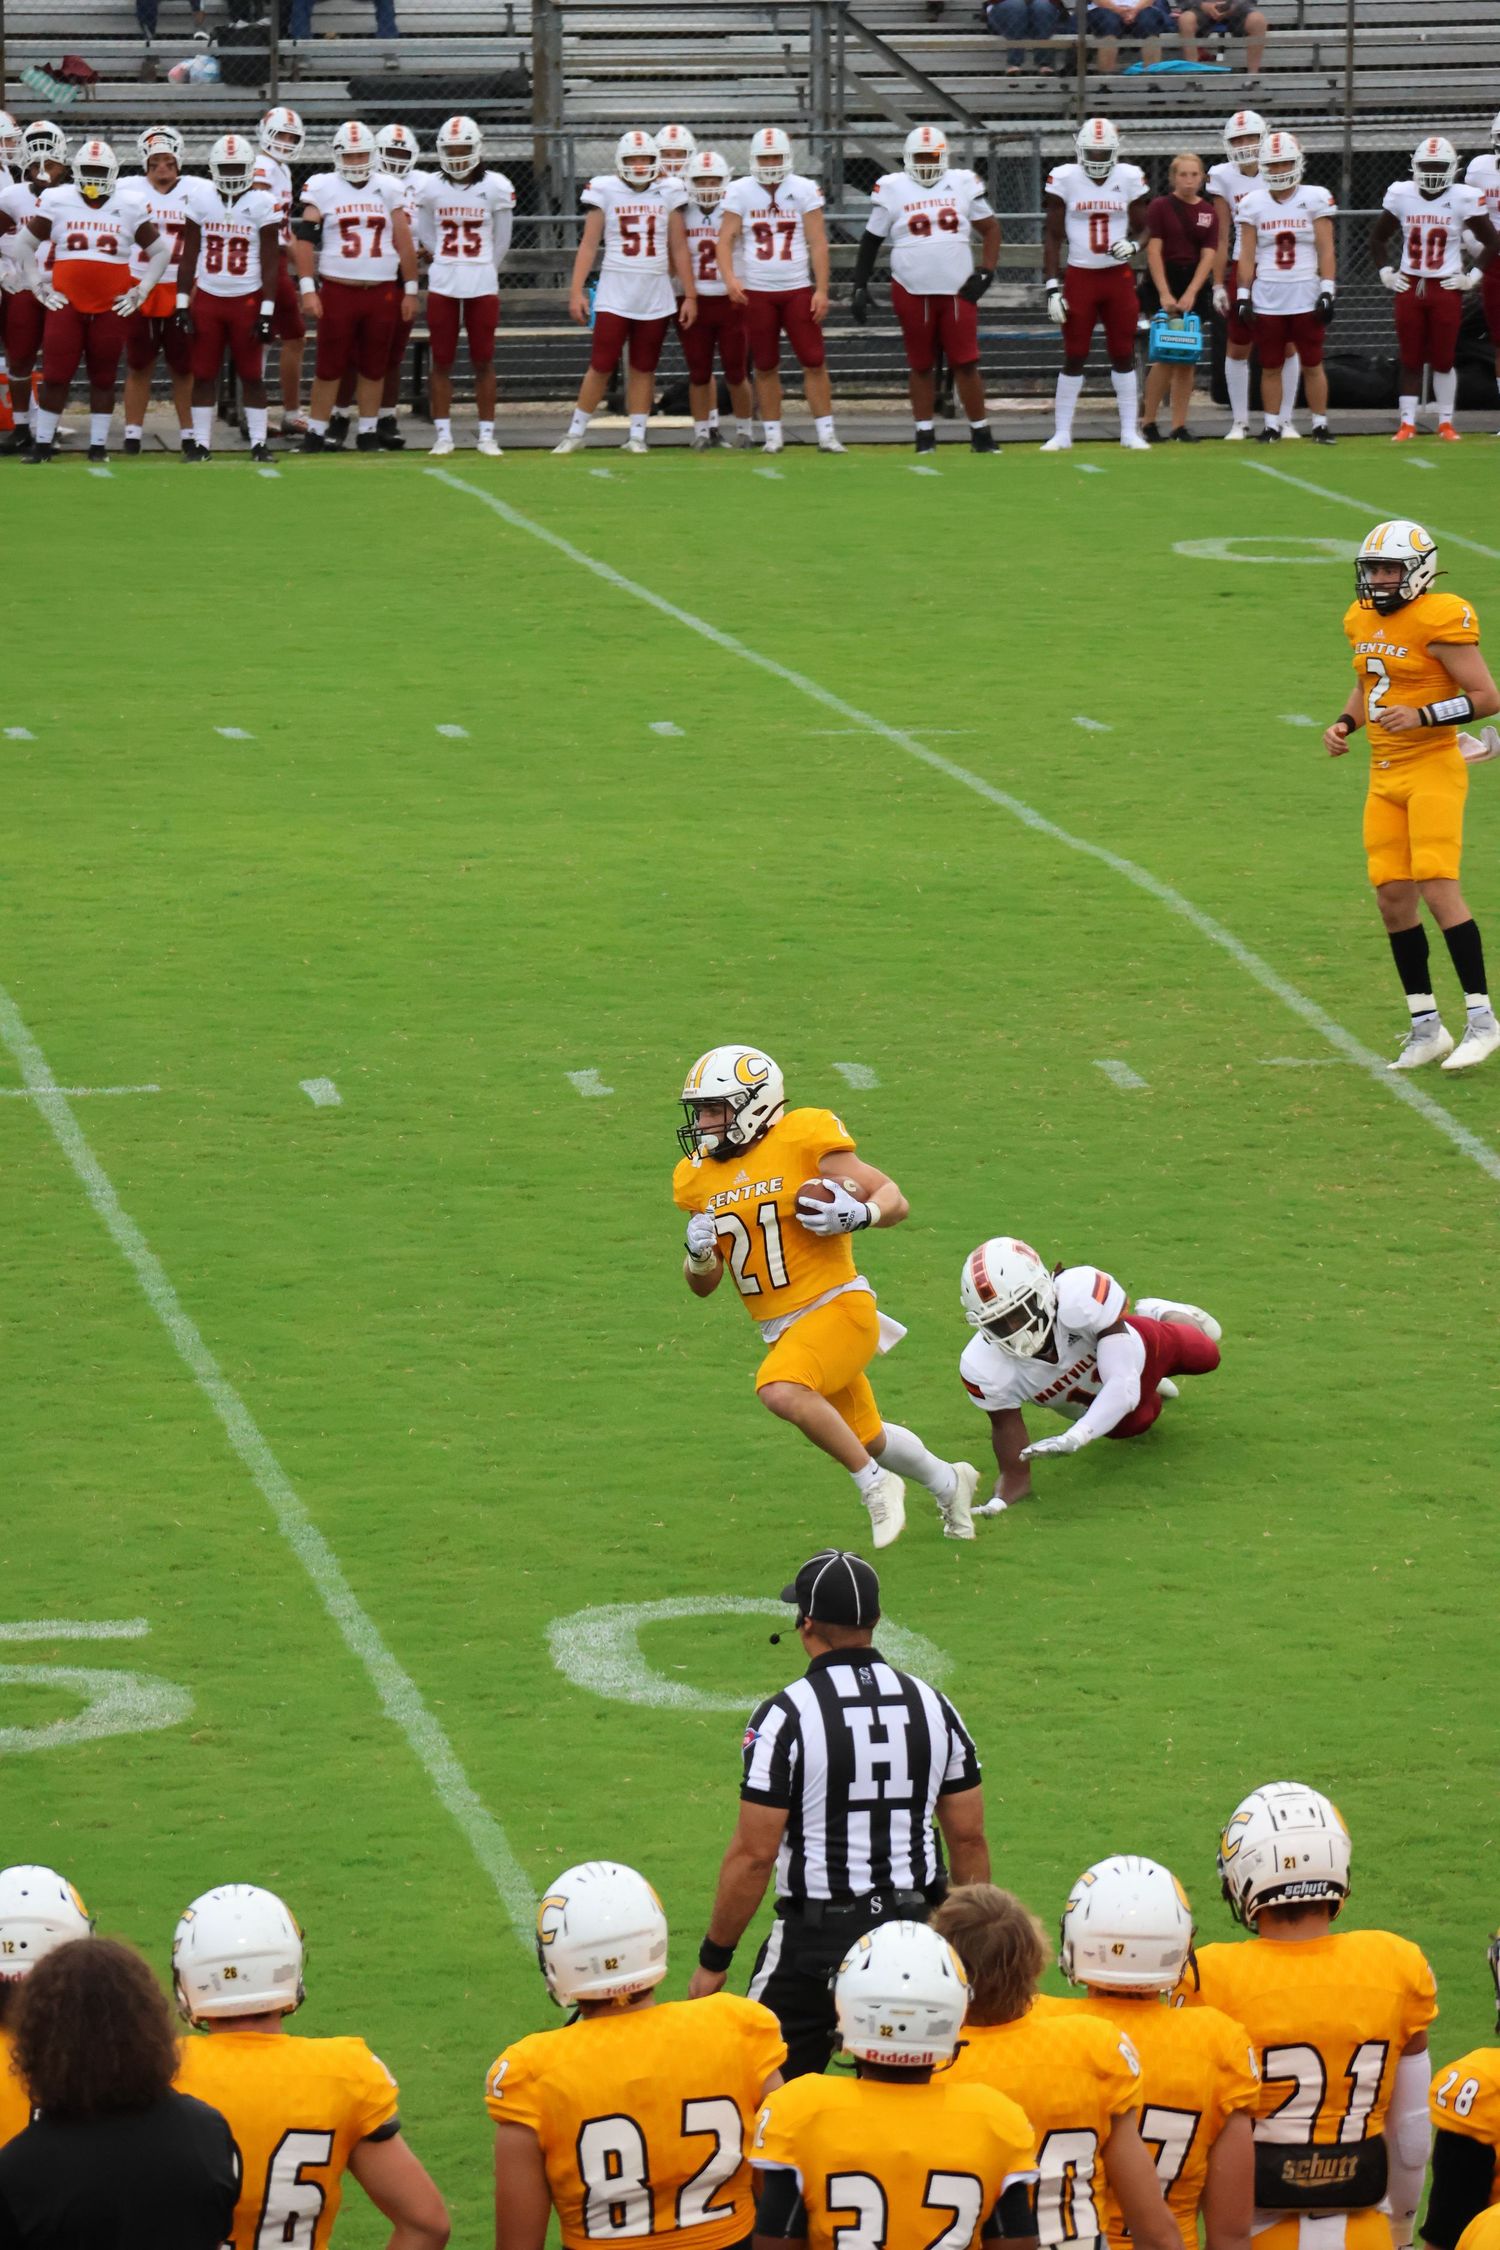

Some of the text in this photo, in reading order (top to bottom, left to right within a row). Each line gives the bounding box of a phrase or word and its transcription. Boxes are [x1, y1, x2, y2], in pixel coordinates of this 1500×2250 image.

[66, 221, 121, 233] MARYVILLE
[336, 204, 384, 215] MARYVILLE
[438, 207, 484, 218] MARYVILLE
[614, 206, 665, 216] MARYVILLE
[205, 234, 249, 275] 88
[339, 216, 387, 259] 57
[441, 219, 483, 257] 25
[619, 216, 656, 257] 51
[752, 222, 797, 261] 97
[1355, 642, 1408, 659] CENTRE
[1365, 657, 1391, 723] 2
[734, 1053, 769, 1087] C
[708, 1176, 784, 1209] CENTRE
[713, 1200, 790, 1297] 21
[1034, 1353, 1098, 1404] MARYVILL
[842, 1704, 914, 1802] H
[1283, 1856, 1297, 1869] 21
[1283, 1880, 1328, 1896] schutt
[2, 1940, 15, 1954] 12
[1111, 1943, 1125, 1956] 47
[866, 2048, 934, 2065] Riddell
[1252, 2040, 1391, 2144] 21
[1436, 2070, 1480, 2118] 28
[575, 2095, 746, 2242] 82
[1282, 2152, 1359, 2179] schutt
[219, 2128, 336, 2250] 6
[825, 2168, 985, 2250] 32
